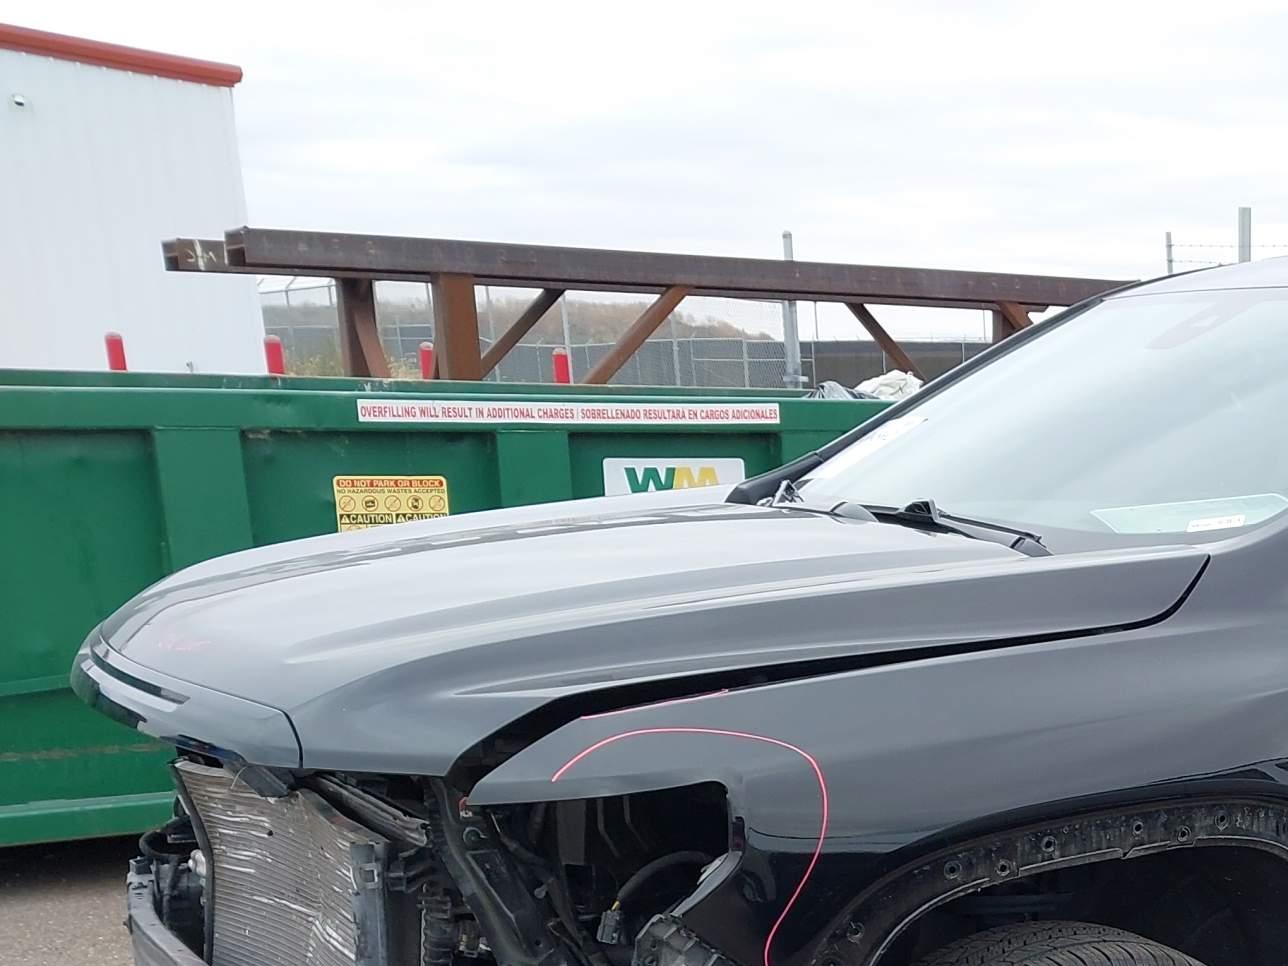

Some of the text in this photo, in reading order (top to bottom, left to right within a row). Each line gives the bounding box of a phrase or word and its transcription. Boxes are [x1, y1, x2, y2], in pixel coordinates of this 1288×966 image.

[360, 406, 417, 418] OVERFILLING
[419, 406, 439, 418] WILL
[441, 407, 473, 418] RESULT
[475, 407, 484, 418] IN
[487, 407, 535, 419] ADDITIONAL
[537, 408, 575, 419] CHARGES
[580, 408, 641, 419] SOBRELLENADO
[688, 409, 698, 419] EN
[700, 409, 729, 420] CARGOS
[731, 408, 778, 419] ADICIONALES
[339, 479, 442, 487] DO NOT PARK OR BLOCK
[624, 467, 720, 493] WM
[349, 514, 392, 523] CAUTION
